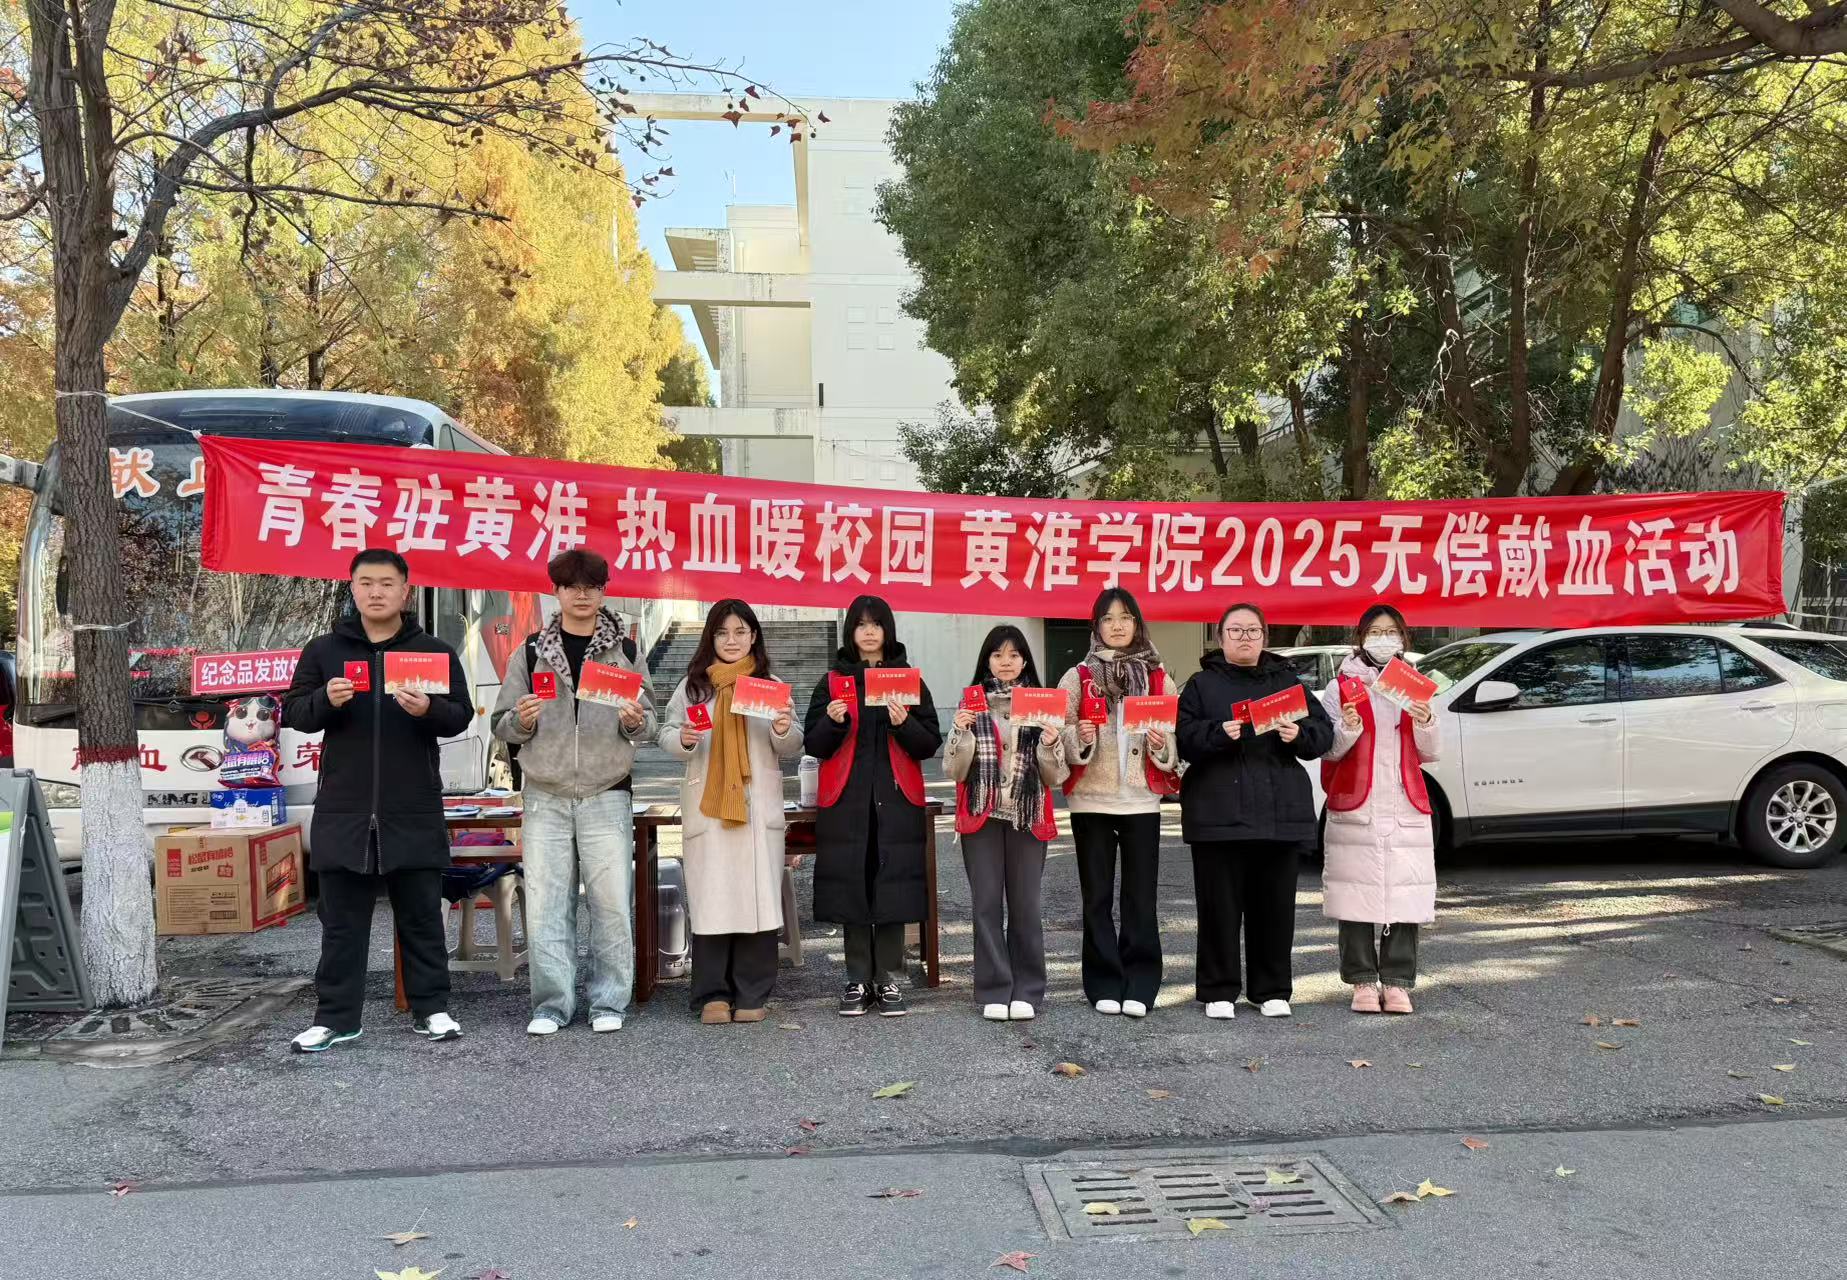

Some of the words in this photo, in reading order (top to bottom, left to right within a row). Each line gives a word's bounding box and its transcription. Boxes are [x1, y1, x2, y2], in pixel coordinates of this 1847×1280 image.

[257, 462, 588, 561] 青春驻黄淮
[614, 487, 936, 587] 热血暖校园
[959, 508, 1741, 599] 黄淮学院2025无偿献血活动
[71, 743, 168, 772] 血
